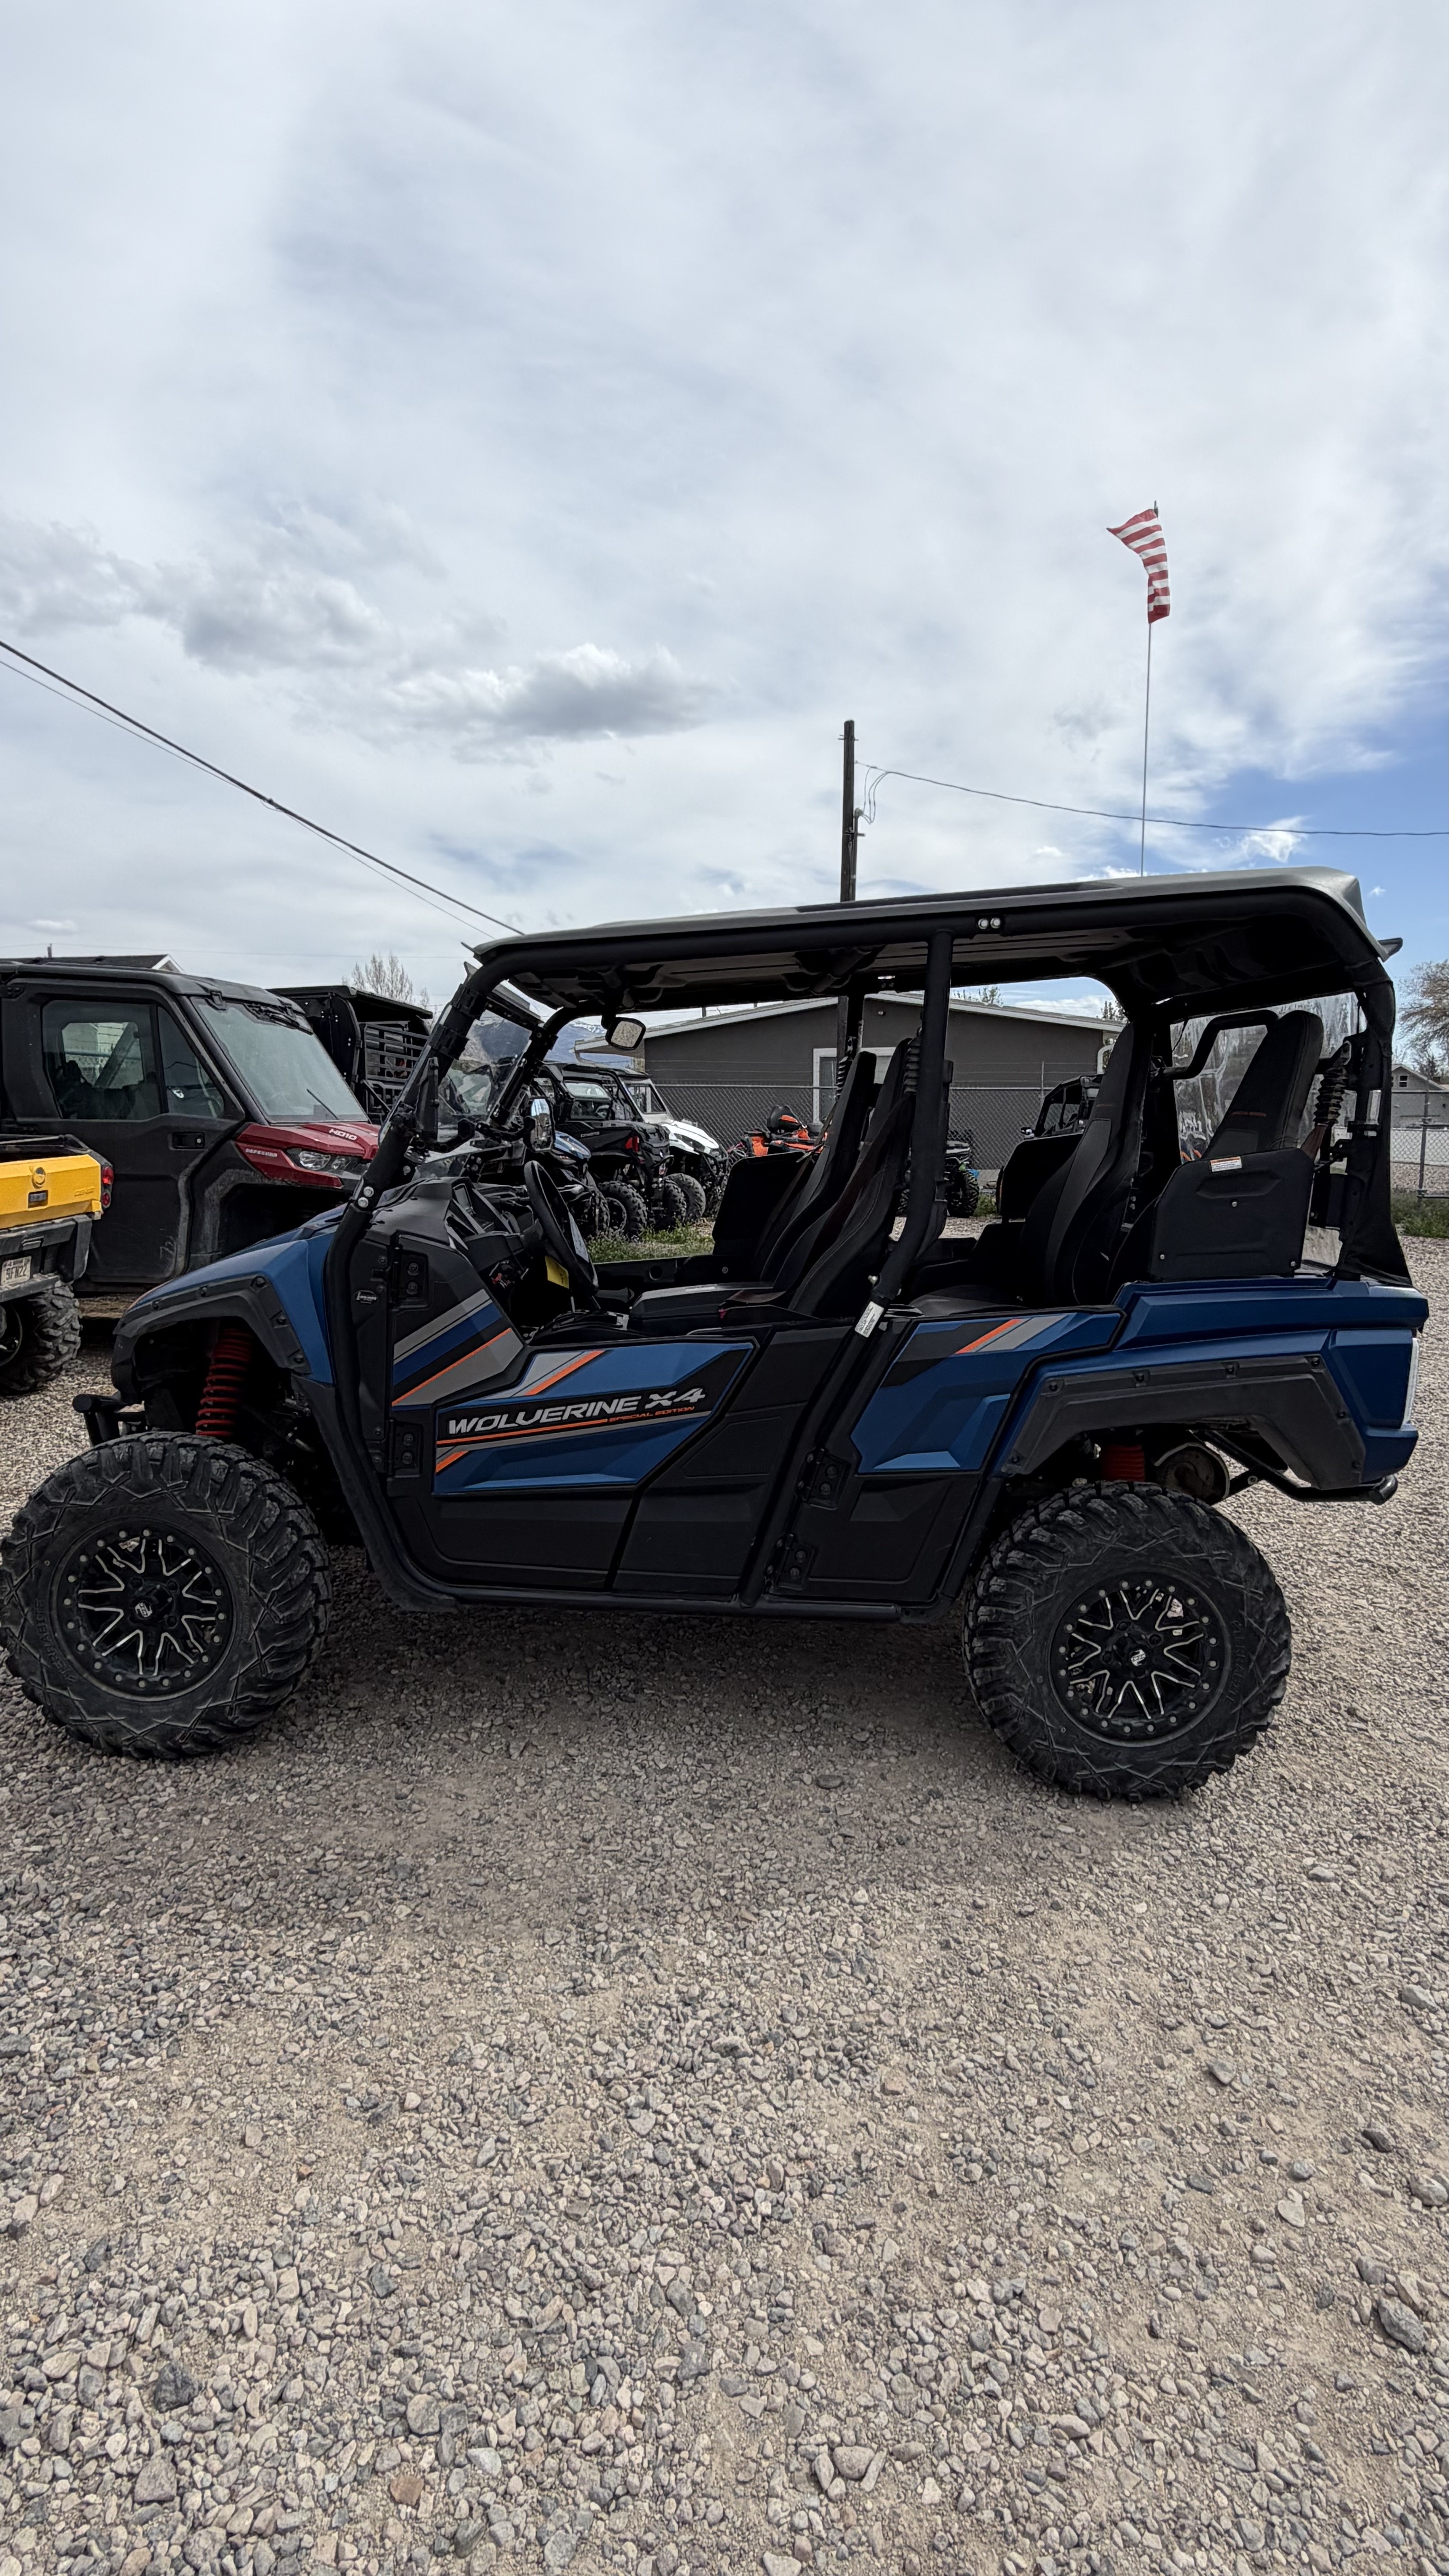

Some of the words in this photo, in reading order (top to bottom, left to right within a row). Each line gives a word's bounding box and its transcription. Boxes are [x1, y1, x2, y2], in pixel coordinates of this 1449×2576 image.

[329, 1128, 357, 1141] HD10
[449, 1396, 641, 1434] WOLVERINE
[645, 1388, 706, 1409] X4
[609, 1412, 653, 1422] SPECIAL
[655, 1406, 695, 1416] EDITION
